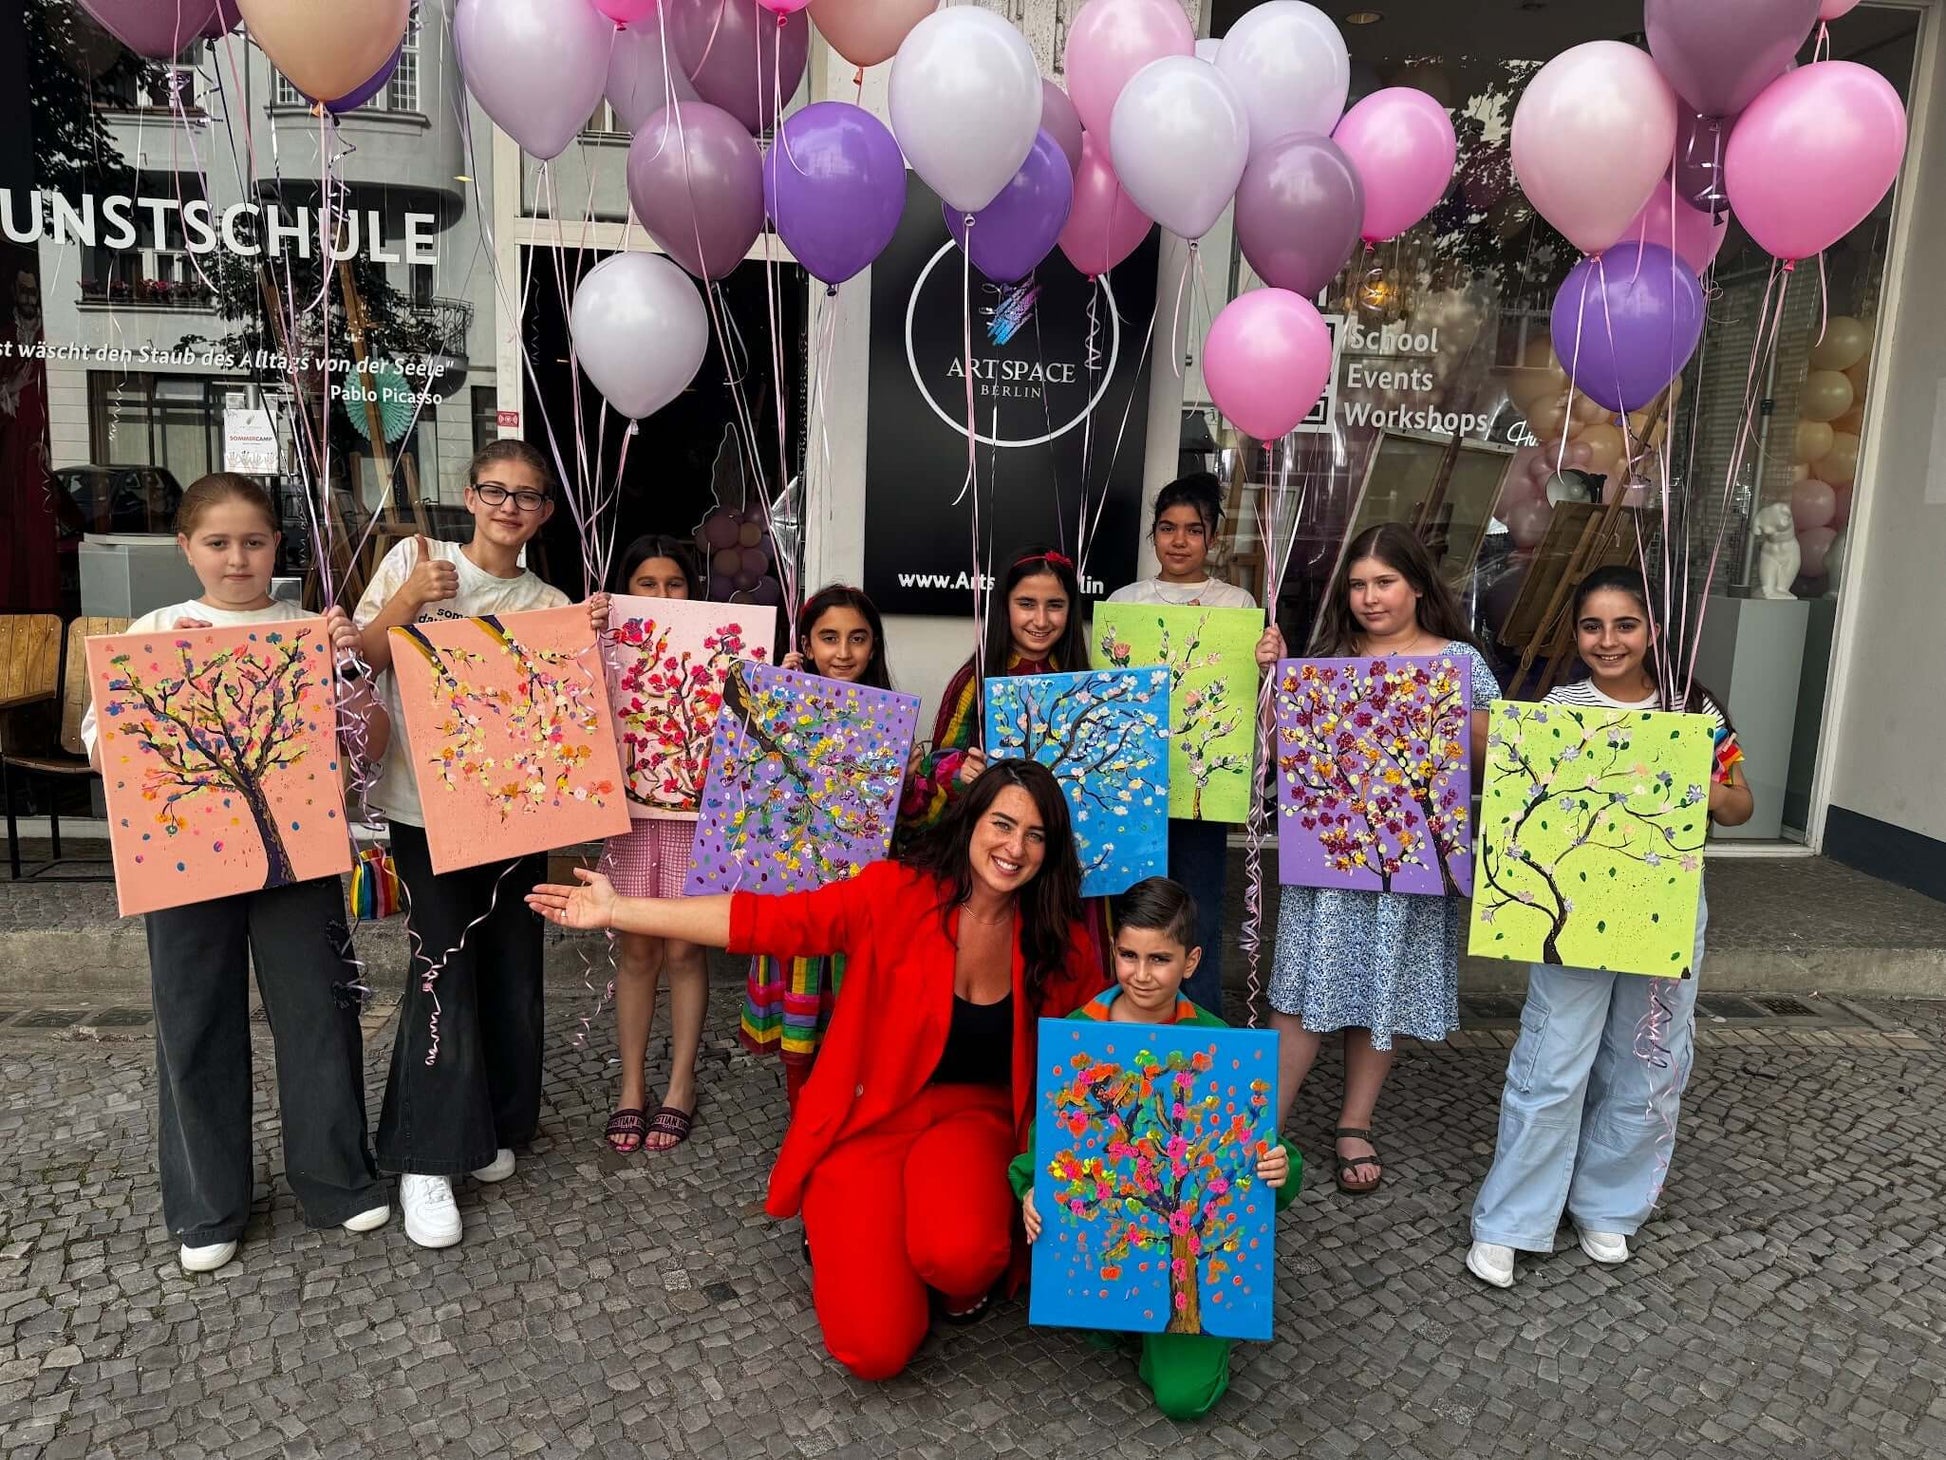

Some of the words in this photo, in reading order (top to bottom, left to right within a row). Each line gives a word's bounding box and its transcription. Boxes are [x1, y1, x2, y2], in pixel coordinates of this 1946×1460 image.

[0, 188, 438, 265] UNSTSCHULE
[1350, 323, 1439, 353] School
[18, 341, 91, 361] wäscht
[95, 343, 132, 363] den
[138, 345, 196, 366] Staub
[201, 348, 235, 368] des
[239, 350, 309, 374] Alltags
[315, 356, 350, 374] von
[356, 355, 389, 375] der
[980, 384, 1042, 399] BERLIN
[1347, 363, 1434, 392] Events
[330, 384, 378, 403] Pablo
[382, 386, 443, 406] Picasso
[1343, 400, 1488, 437] Workshops
[437, 608, 469, 620] som
